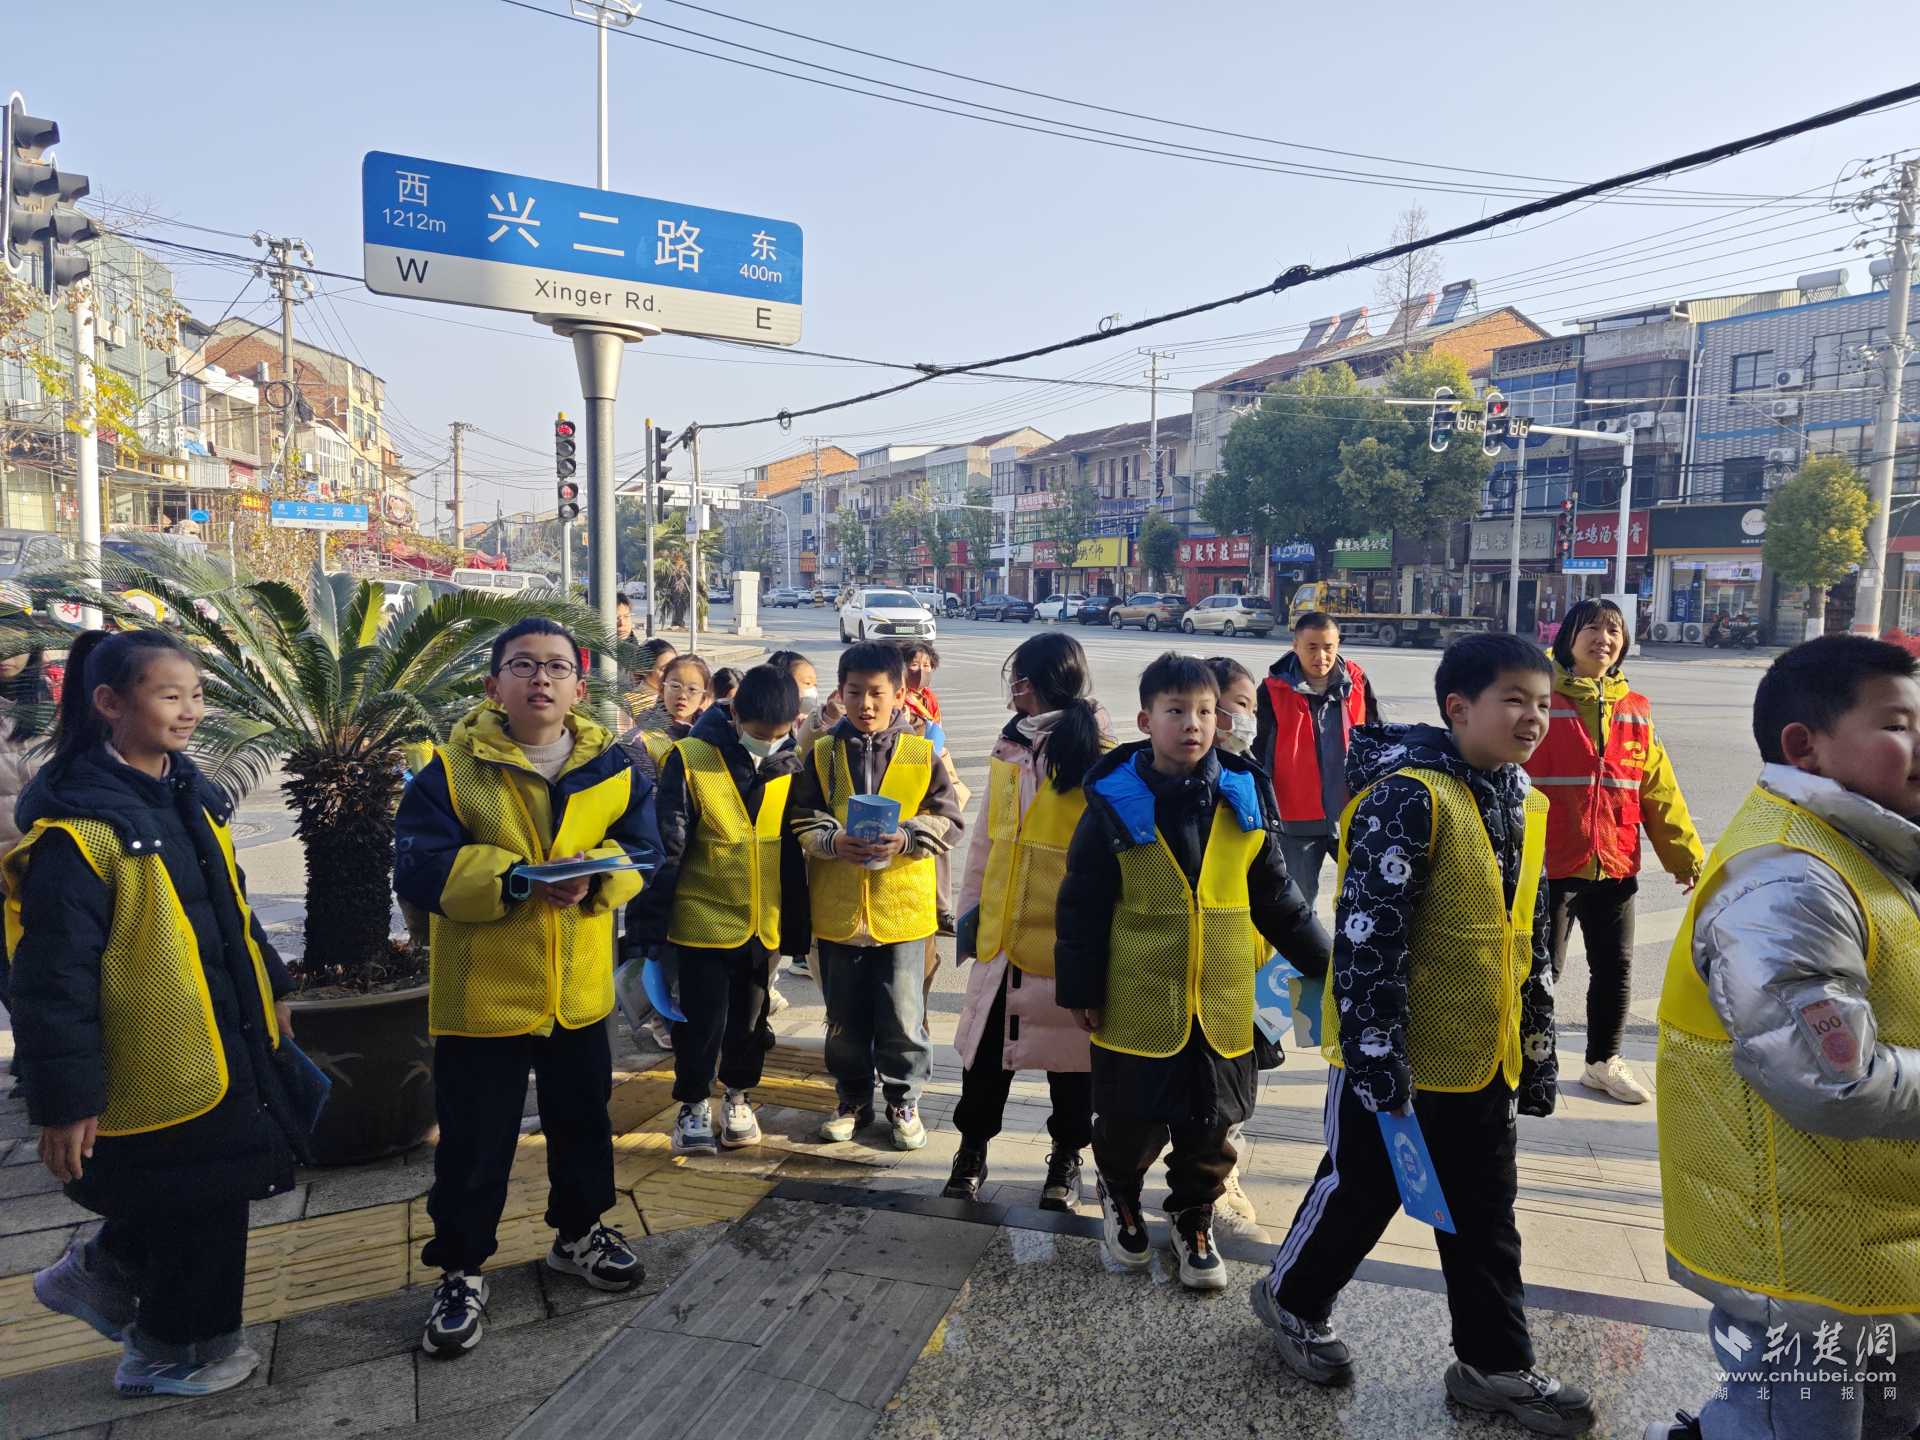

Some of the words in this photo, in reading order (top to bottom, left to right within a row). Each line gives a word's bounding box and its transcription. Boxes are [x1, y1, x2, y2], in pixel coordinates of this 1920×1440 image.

[396, 170, 430, 207] 西
[382, 208, 446, 233] 1212m
[487, 191, 704, 273] 兴二路
[750, 229, 778, 262] 东
[396, 256, 429, 284] W
[739, 263, 783, 283] 400m
[534, 278, 612, 307] Xinger
[625, 292, 662, 313] Rd.
[756, 307, 773, 330] E
[296, 505, 344, 518] 兴二路
[1811, 1015, 1842, 1036] 100
